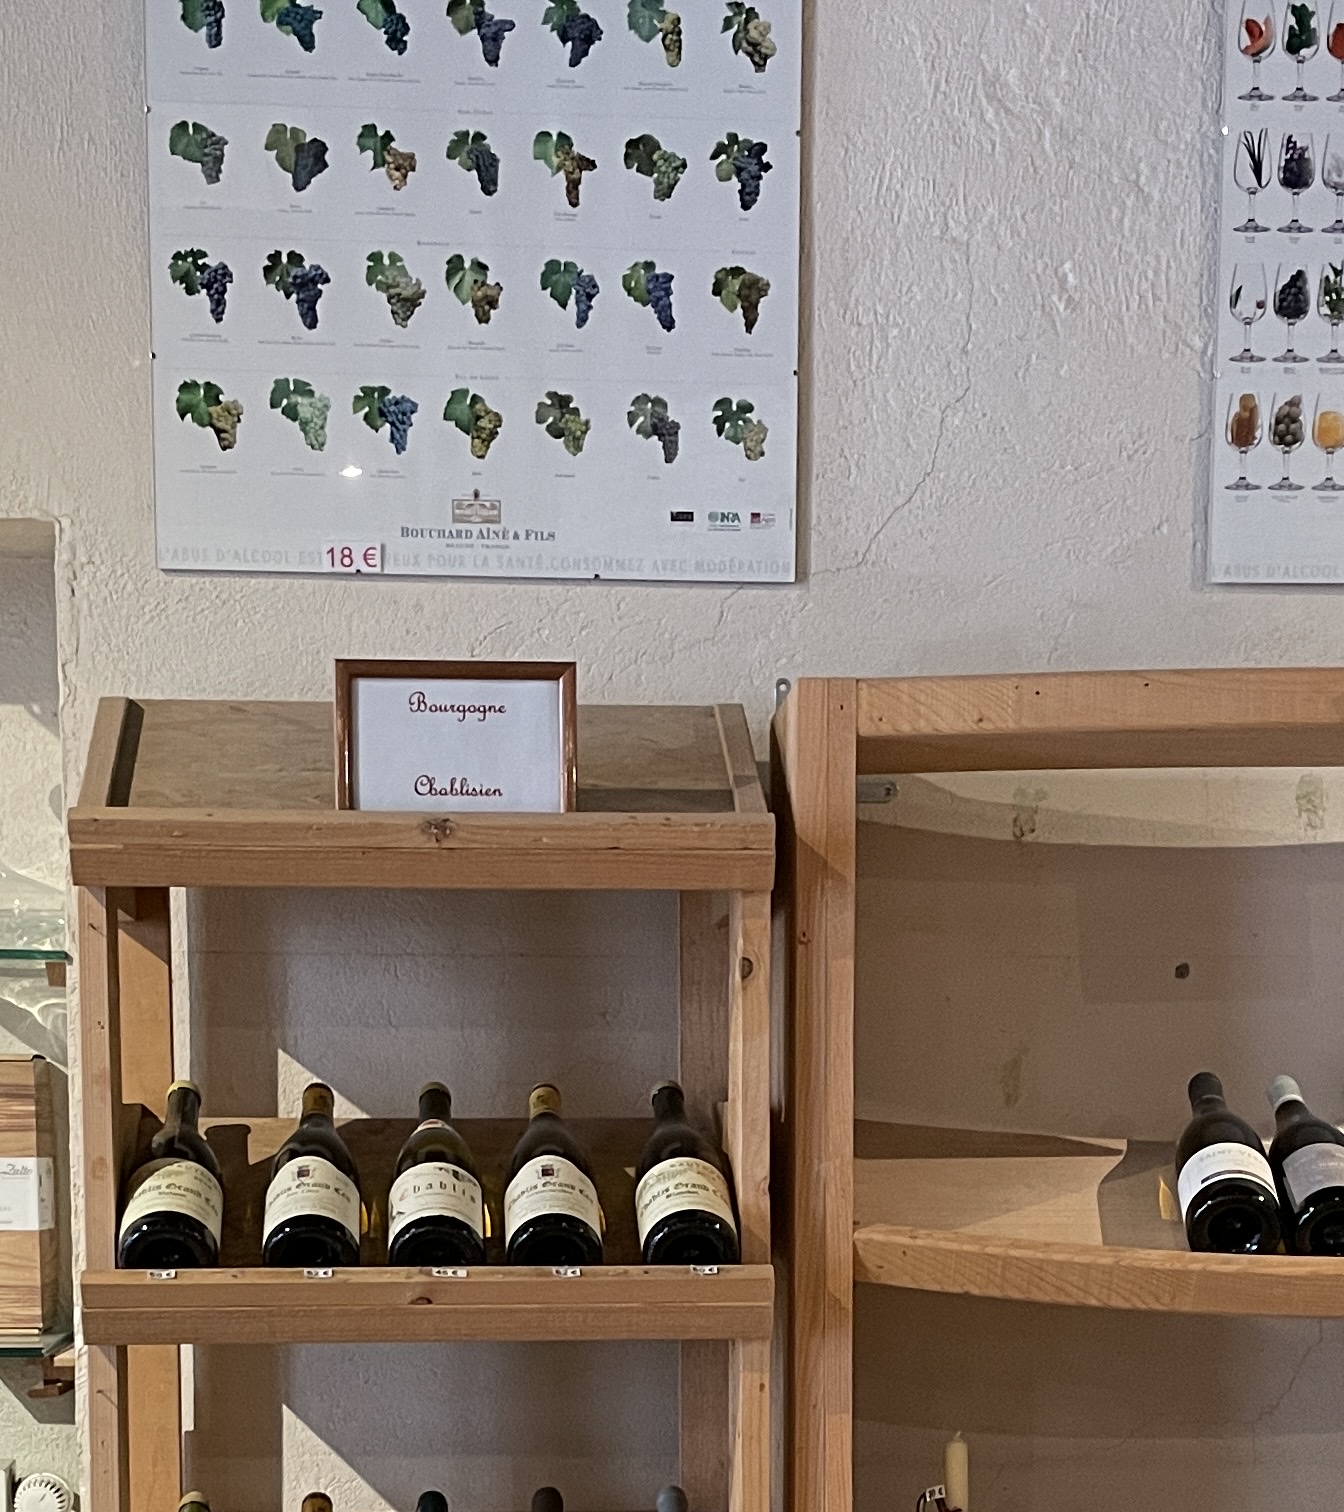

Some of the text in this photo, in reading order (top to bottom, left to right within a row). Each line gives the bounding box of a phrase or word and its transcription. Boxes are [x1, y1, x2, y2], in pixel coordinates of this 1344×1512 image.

[400, 526, 474, 540] BOUCHARD
[512, 531, 520, 541] &
[524, 530, 556, 542] FILS
[326, 546, 354, 569] 18
[362, 546, 379, 568] €
[408, 691, 506, 722] Bourgogne
[414, 774, 504, 798] Chablisien
